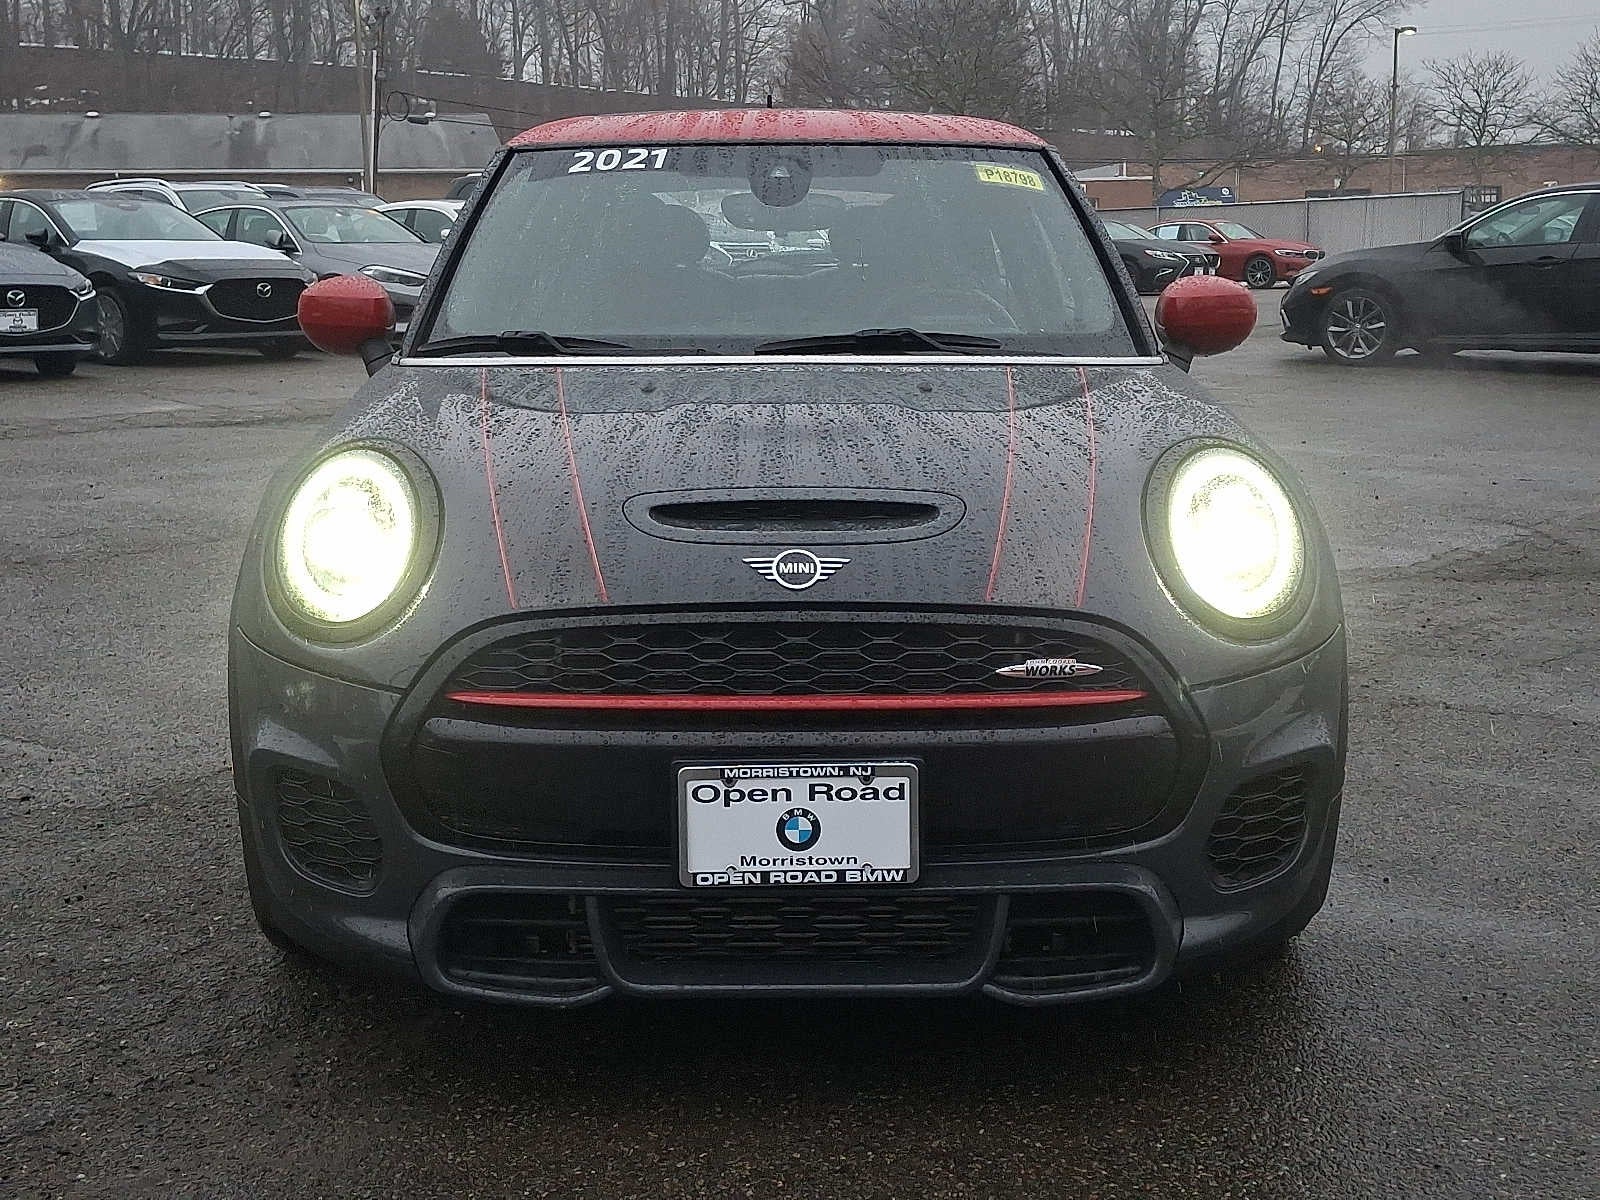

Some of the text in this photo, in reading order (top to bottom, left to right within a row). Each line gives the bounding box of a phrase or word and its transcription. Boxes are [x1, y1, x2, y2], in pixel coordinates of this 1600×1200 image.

[568, 148, 668, 174] 2021
[779, 562, 816, 574] MINI
[1025, 664, 1076, 676] WORKS
[850, 766, 872, 776] NJ
[691, 783, 906, 807] Open Road
[782, 808, 816, 821] BMW
[740, 855, 858, 867] Morristown
[696, 869, 904, 885] OPEN ROAD BMW
